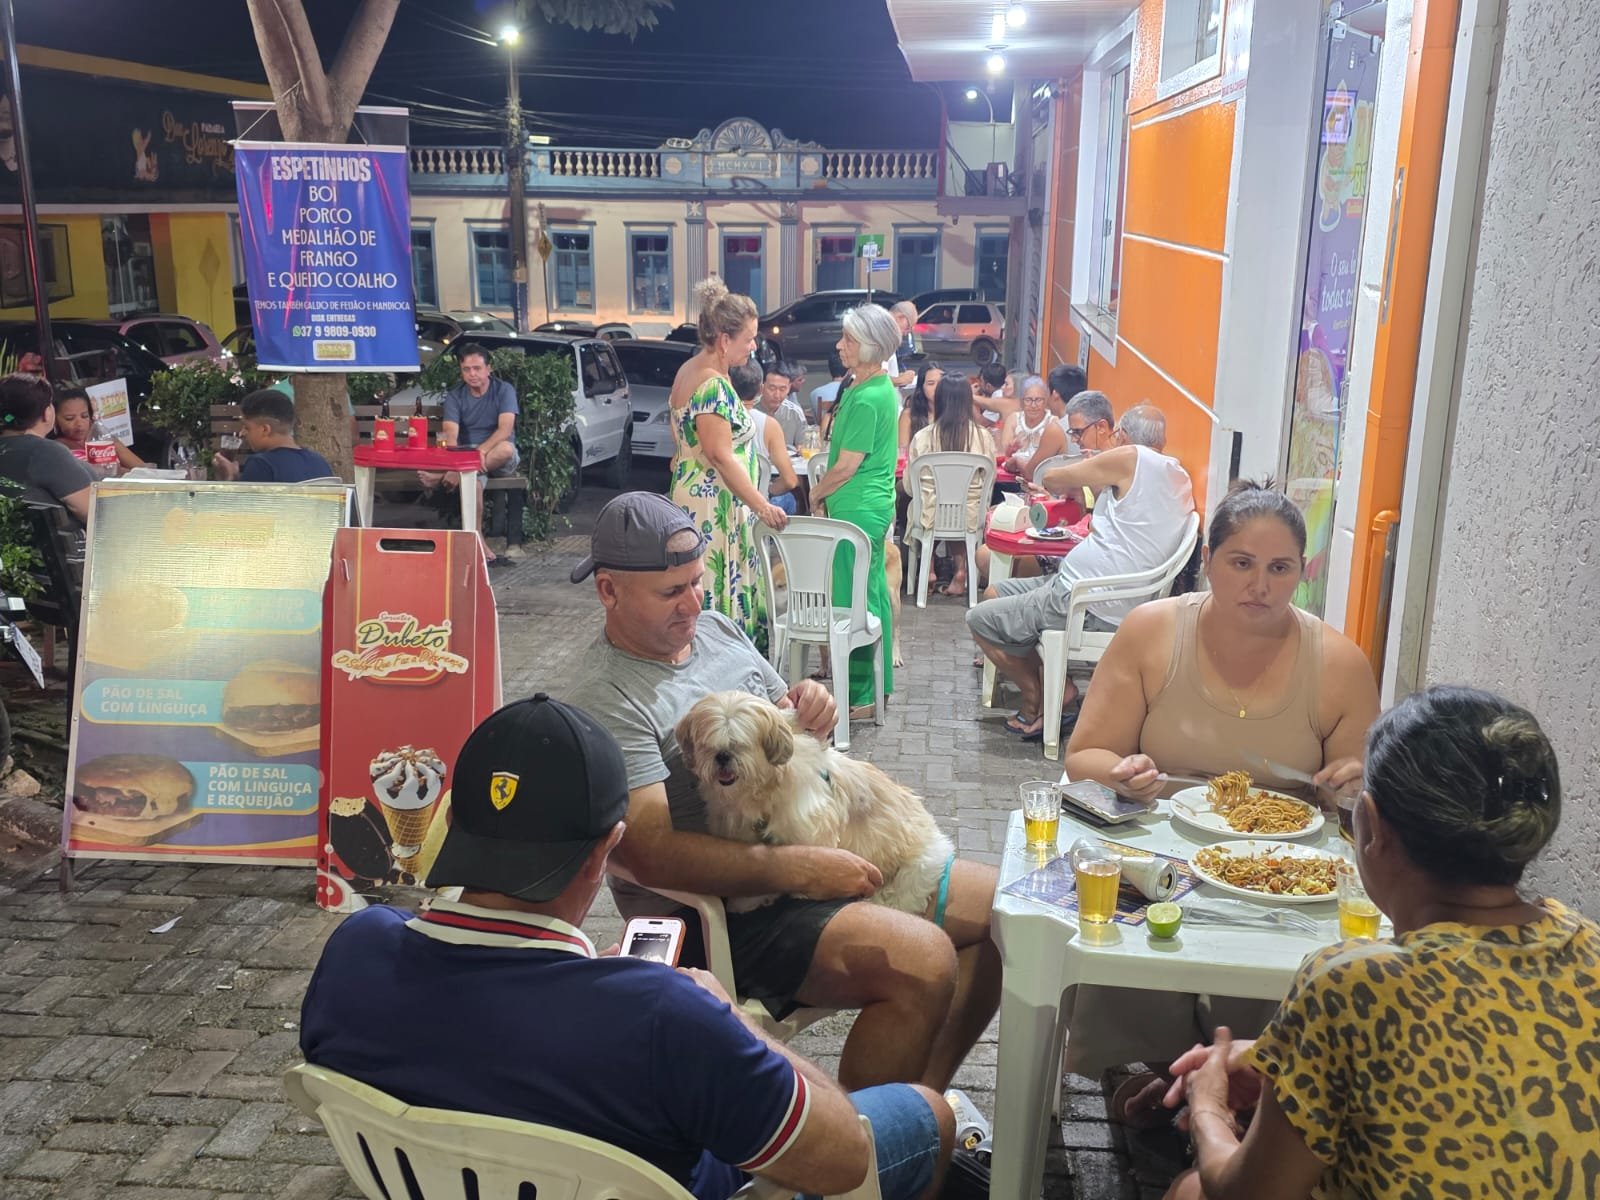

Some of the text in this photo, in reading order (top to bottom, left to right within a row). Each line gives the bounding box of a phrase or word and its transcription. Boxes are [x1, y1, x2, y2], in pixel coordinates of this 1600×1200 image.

[271, 156, 371, 182] ESPETINHOS
[309, 185, 337, 202] BOI
[300, 207, 352, 224] PORCO
[282, 227, 376, 246] MEDALHÃO DE
[300, 250, 358, 267] FRANGO
[268, 272, 397, 291] E QUEIJO COALHO
[303, 300, 329, 310] CALDO
[330, 301, 338, 310] DE
[367, 301, 371, 310] E
[372, 300, 410, 310] MANDIOCA
[301, 325, 377, 337] 37 9 9809-0930
[358, 620, 449, 648] Dubeto
[102, 684, 183, 700] PÃO DE SAL
[101, 700, 208, 718] COM LINGUIÇA
[209, 763, 288, 779] PÃO DE SAL
[208, 780, 312, 796] COM LINGUIÇA
[207, 793, 294, 810] E REQUEIJÃO
